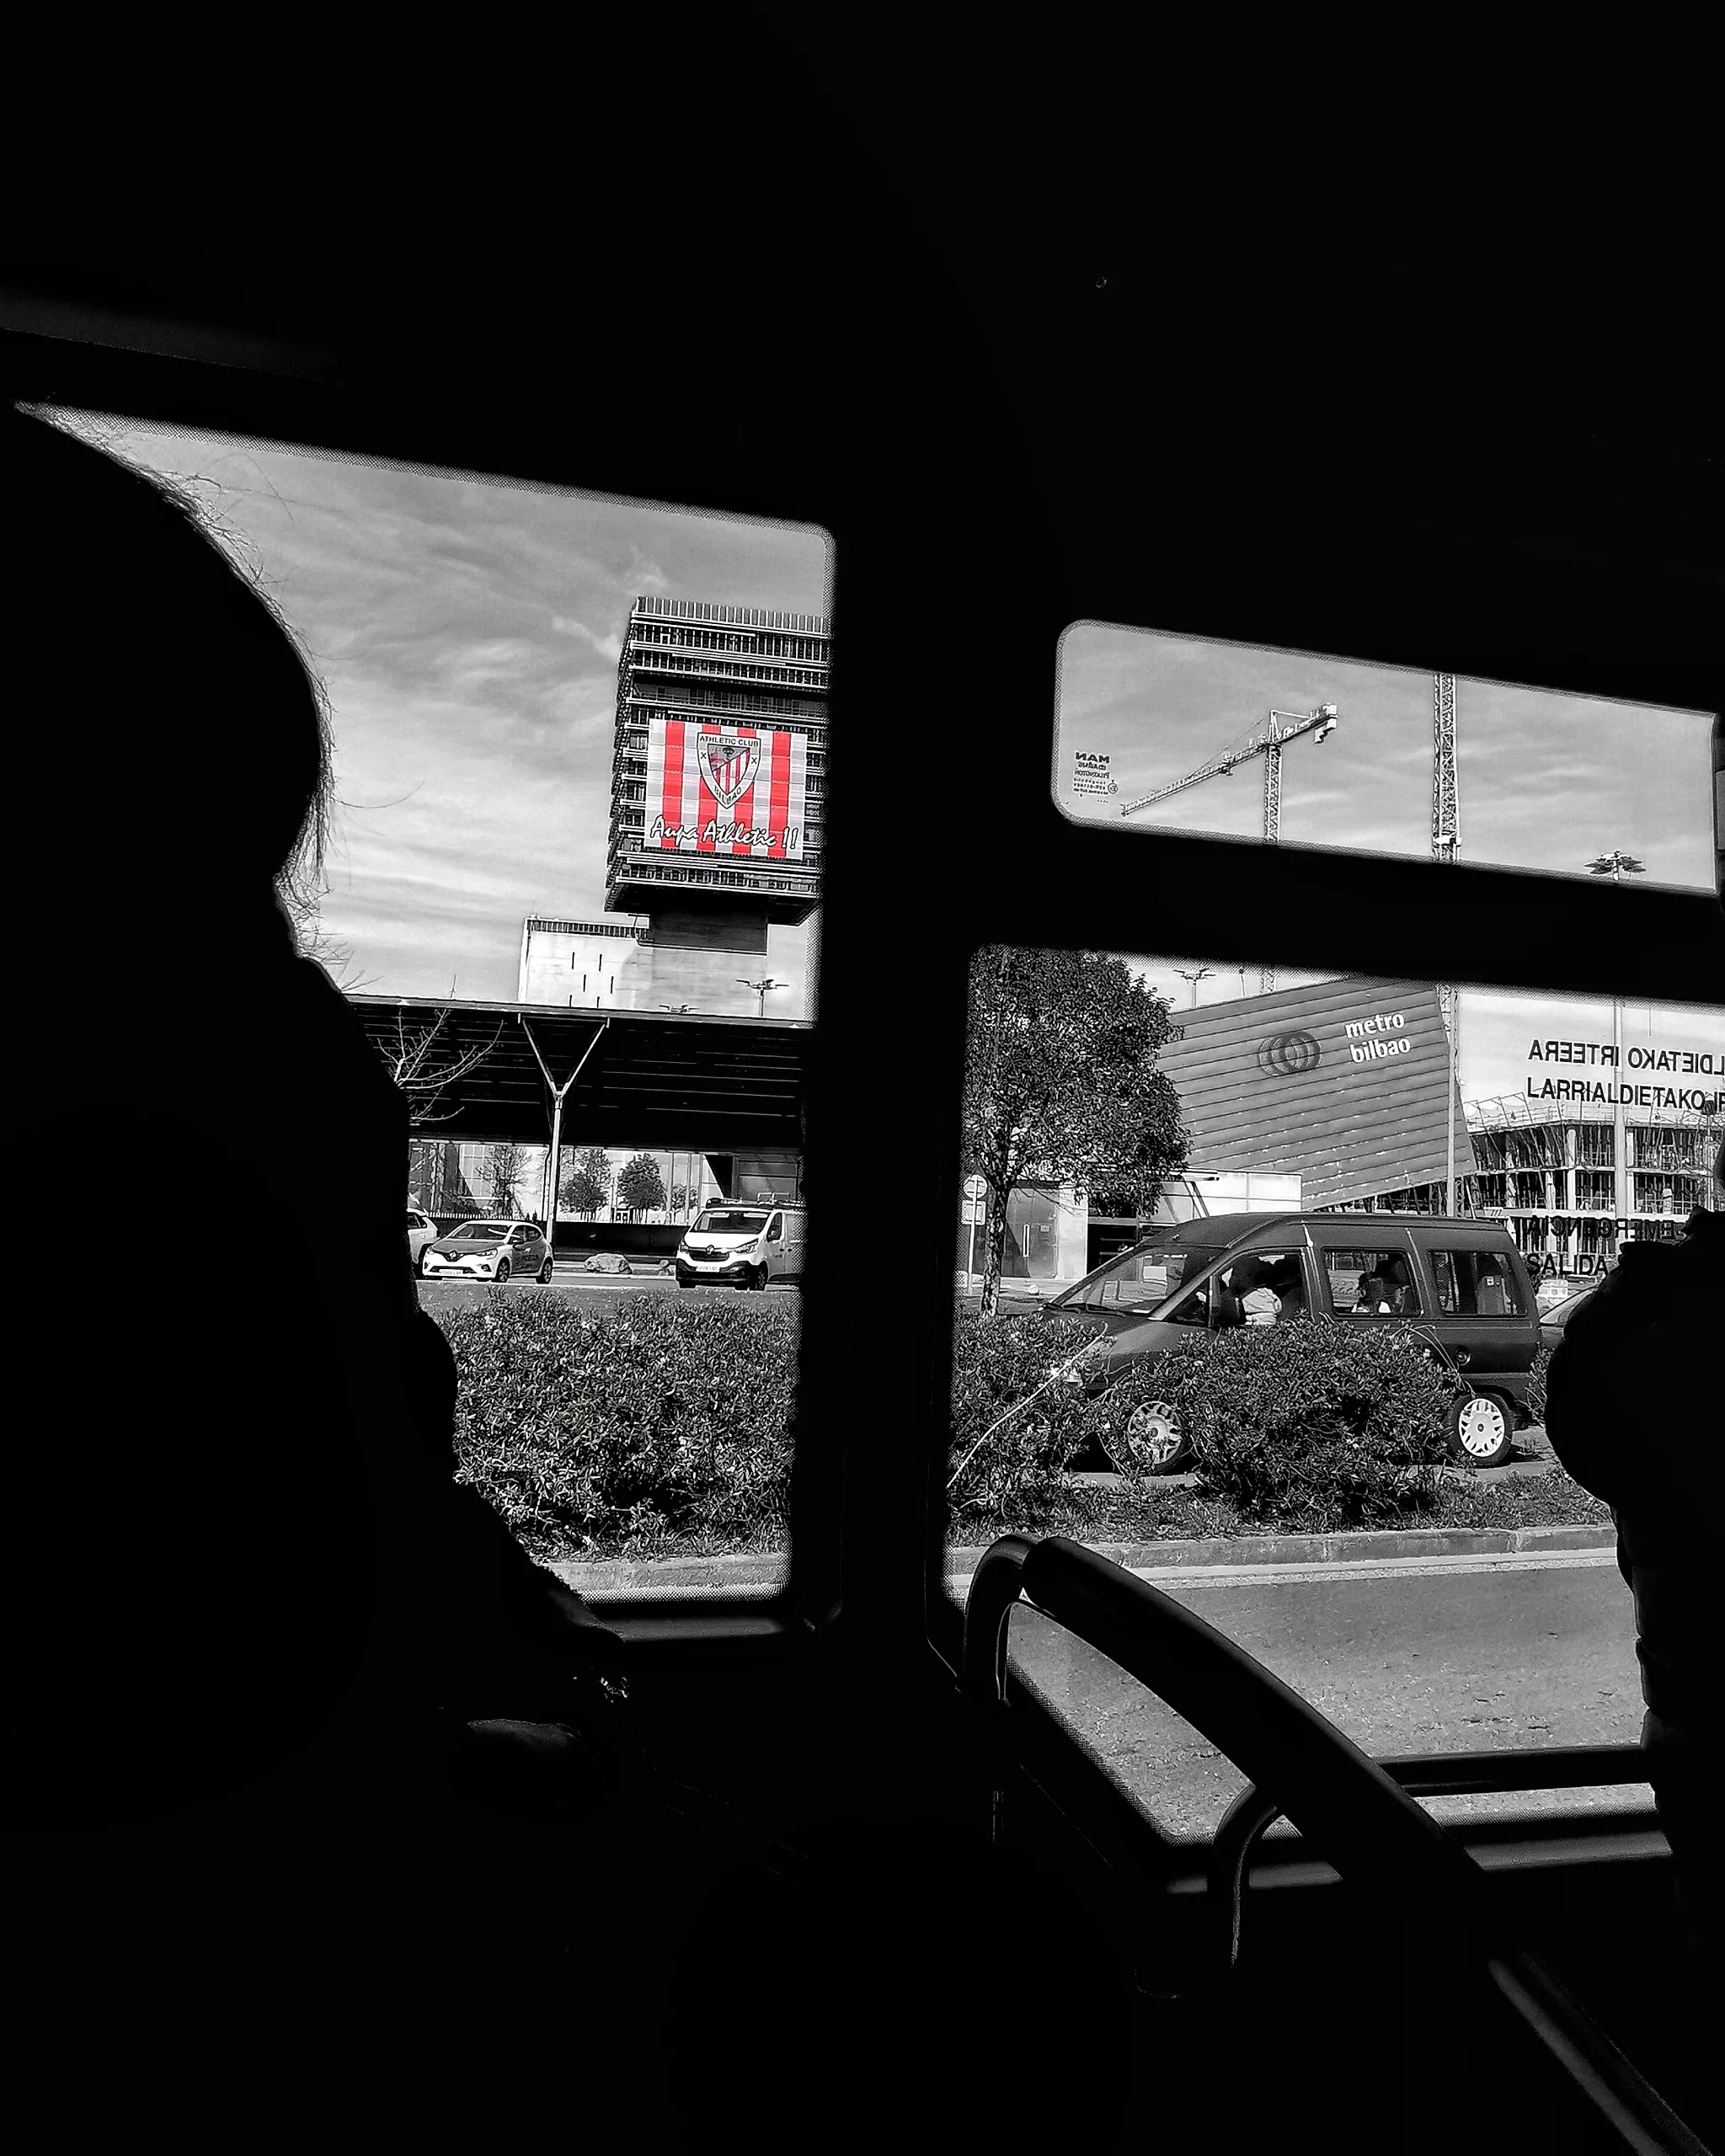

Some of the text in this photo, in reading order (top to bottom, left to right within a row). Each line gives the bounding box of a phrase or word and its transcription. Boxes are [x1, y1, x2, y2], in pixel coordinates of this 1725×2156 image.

[700, 735, 759, 748] ATHLETIC CLUB
[713, 784, 742, 805] BILBAO
[650, 814, 698, 846] Aupa
[702, 819, 777, 846] Athletic
[1344, 1013, 1405, 1039] metro
[1348, 1038, 1411, 1064] bilbao
[1527, 1076, 1706, 1111] LARRIALDIETAKO
[1525, 1252, 1610, 1276] SALIDA
